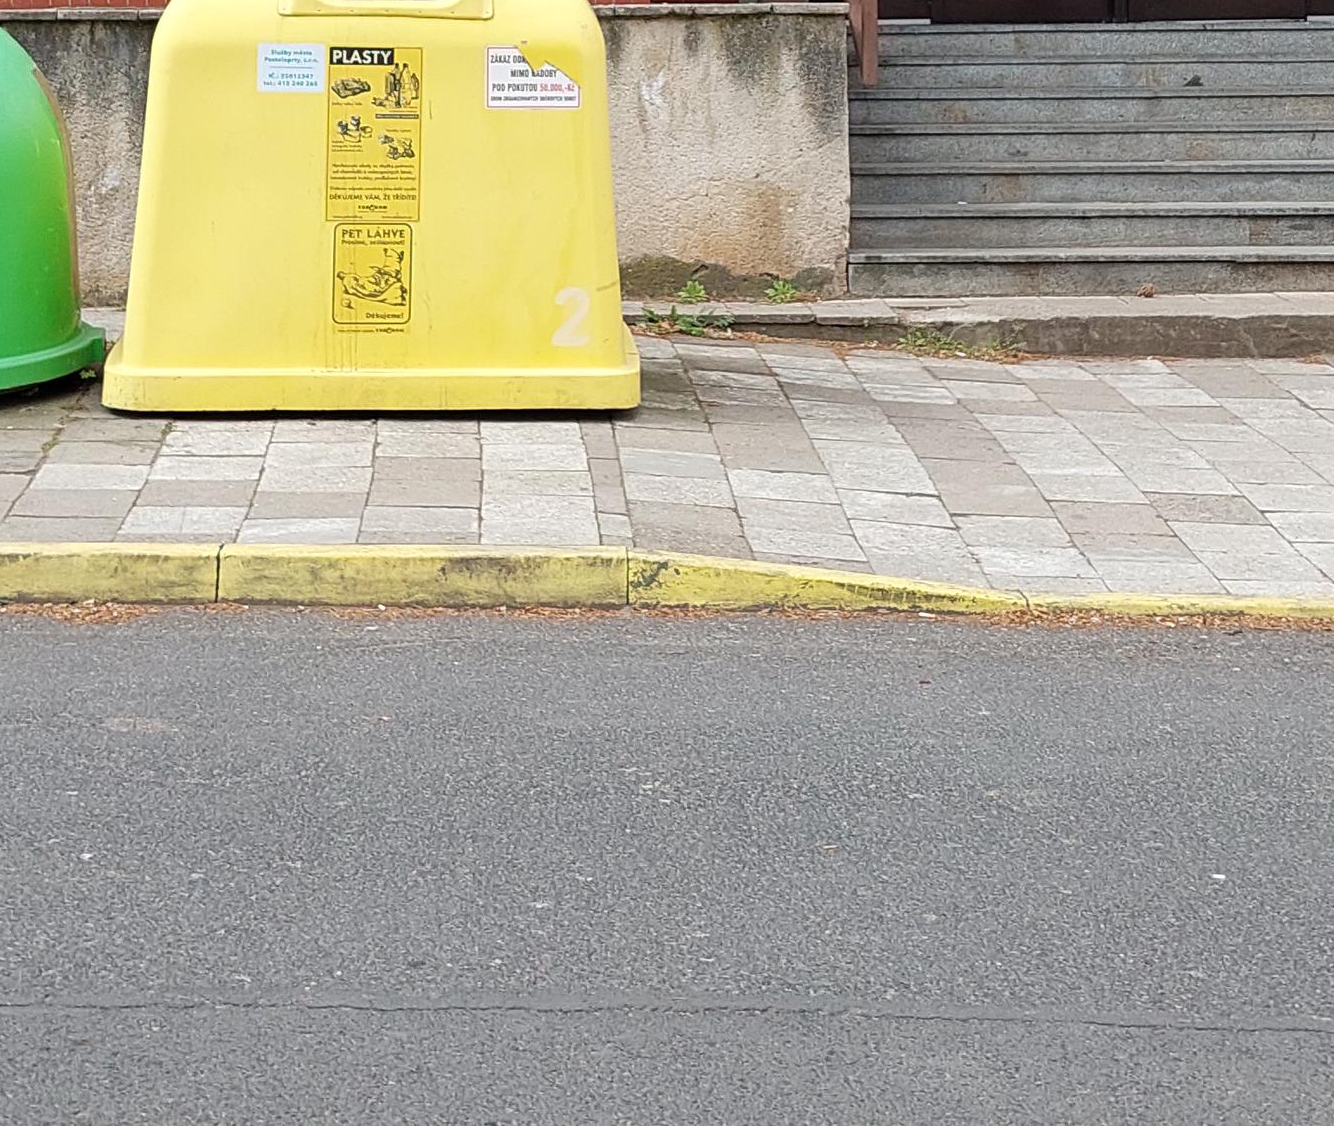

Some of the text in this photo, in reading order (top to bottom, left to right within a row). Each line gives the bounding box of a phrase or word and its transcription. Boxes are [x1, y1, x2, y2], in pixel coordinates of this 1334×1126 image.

[331, 49, 392, 64] PLASTY
[490, 53, 511, 64] ZÁKAZ
[510, 69, 530, 78] MIMO
[492, 83, 506, 92] POD
[507, 83, 538, 92] POKUTOU
[341, 226, 406, 239] PET LÁHVE
[551, 287, 590, 347] 2
